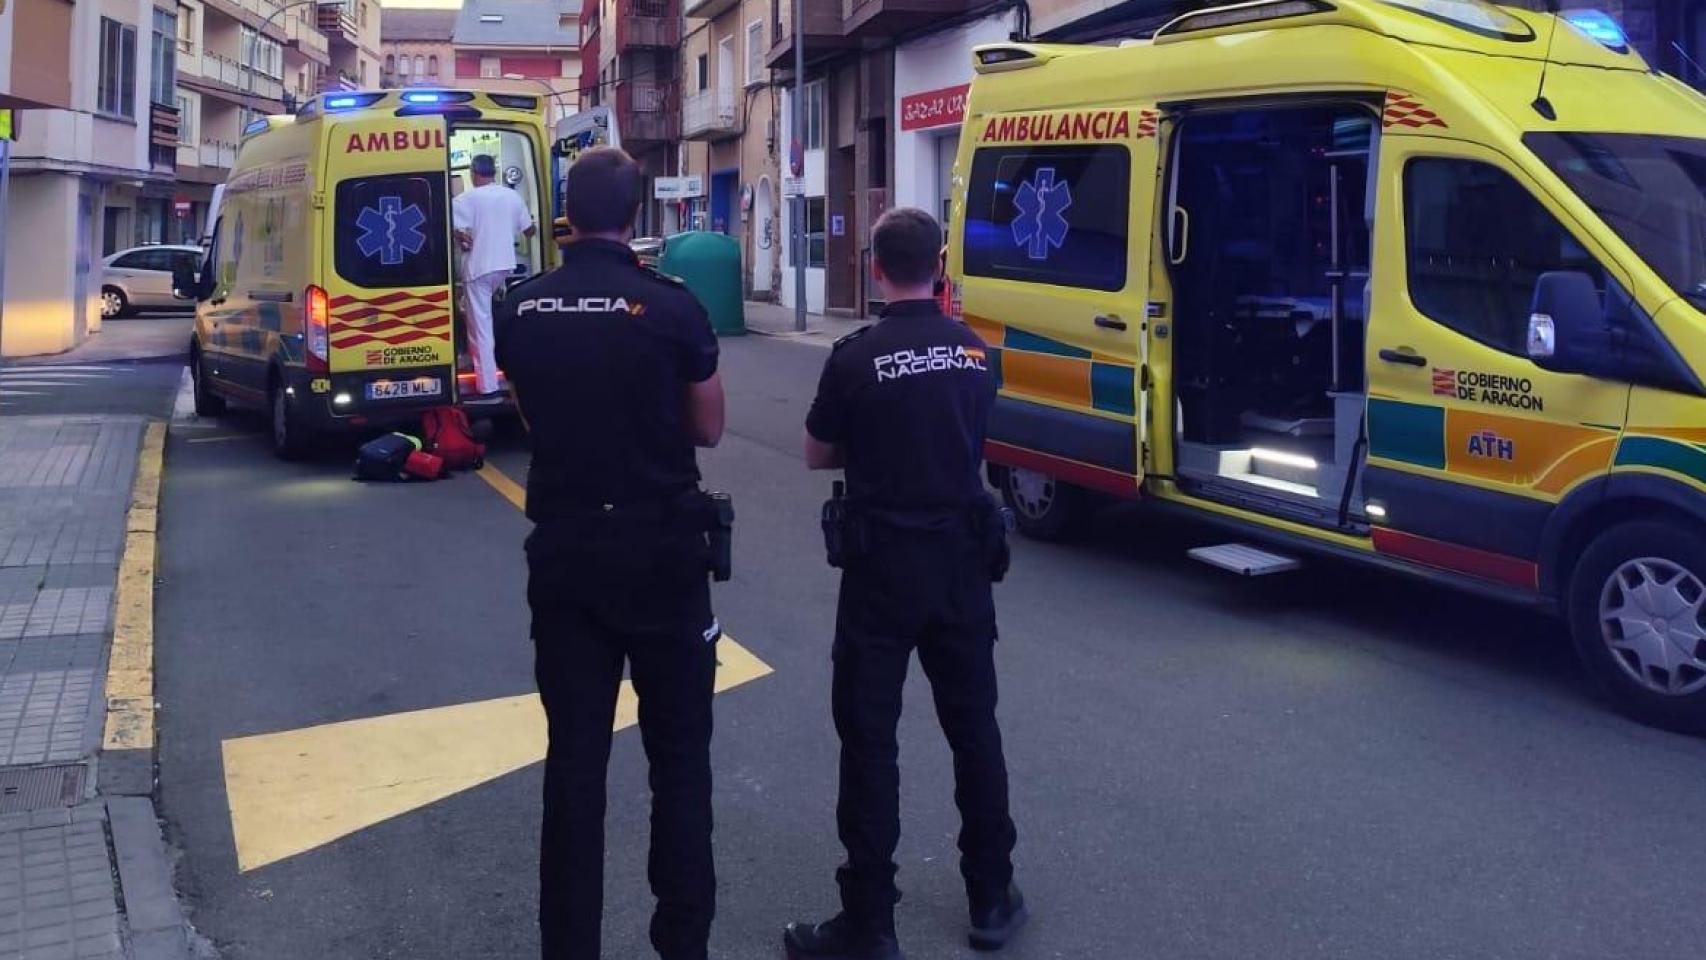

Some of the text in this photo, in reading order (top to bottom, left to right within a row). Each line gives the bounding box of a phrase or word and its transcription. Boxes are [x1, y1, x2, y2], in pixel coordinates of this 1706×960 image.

[983, 110, 1130, 142] AMBULANCIA
[346, 129, 445, 153] AMBUL
[517, 297, 630, 316] POLICIA
[383, 346, 432, 356] GOBIERNO
[400, 353, 439, 363] ARAGON
[874, 345, 968, 370] POLICIA
[877, 358, 987, 382] NACIONAL
[1457, 371, 1532, 393] GOBIERNO
[375, 379, 439, 396] 6428 MLJ
[1457, 386, 1544, 412] DE ARAGON
[1468, 431, 1513, 460] ATH
